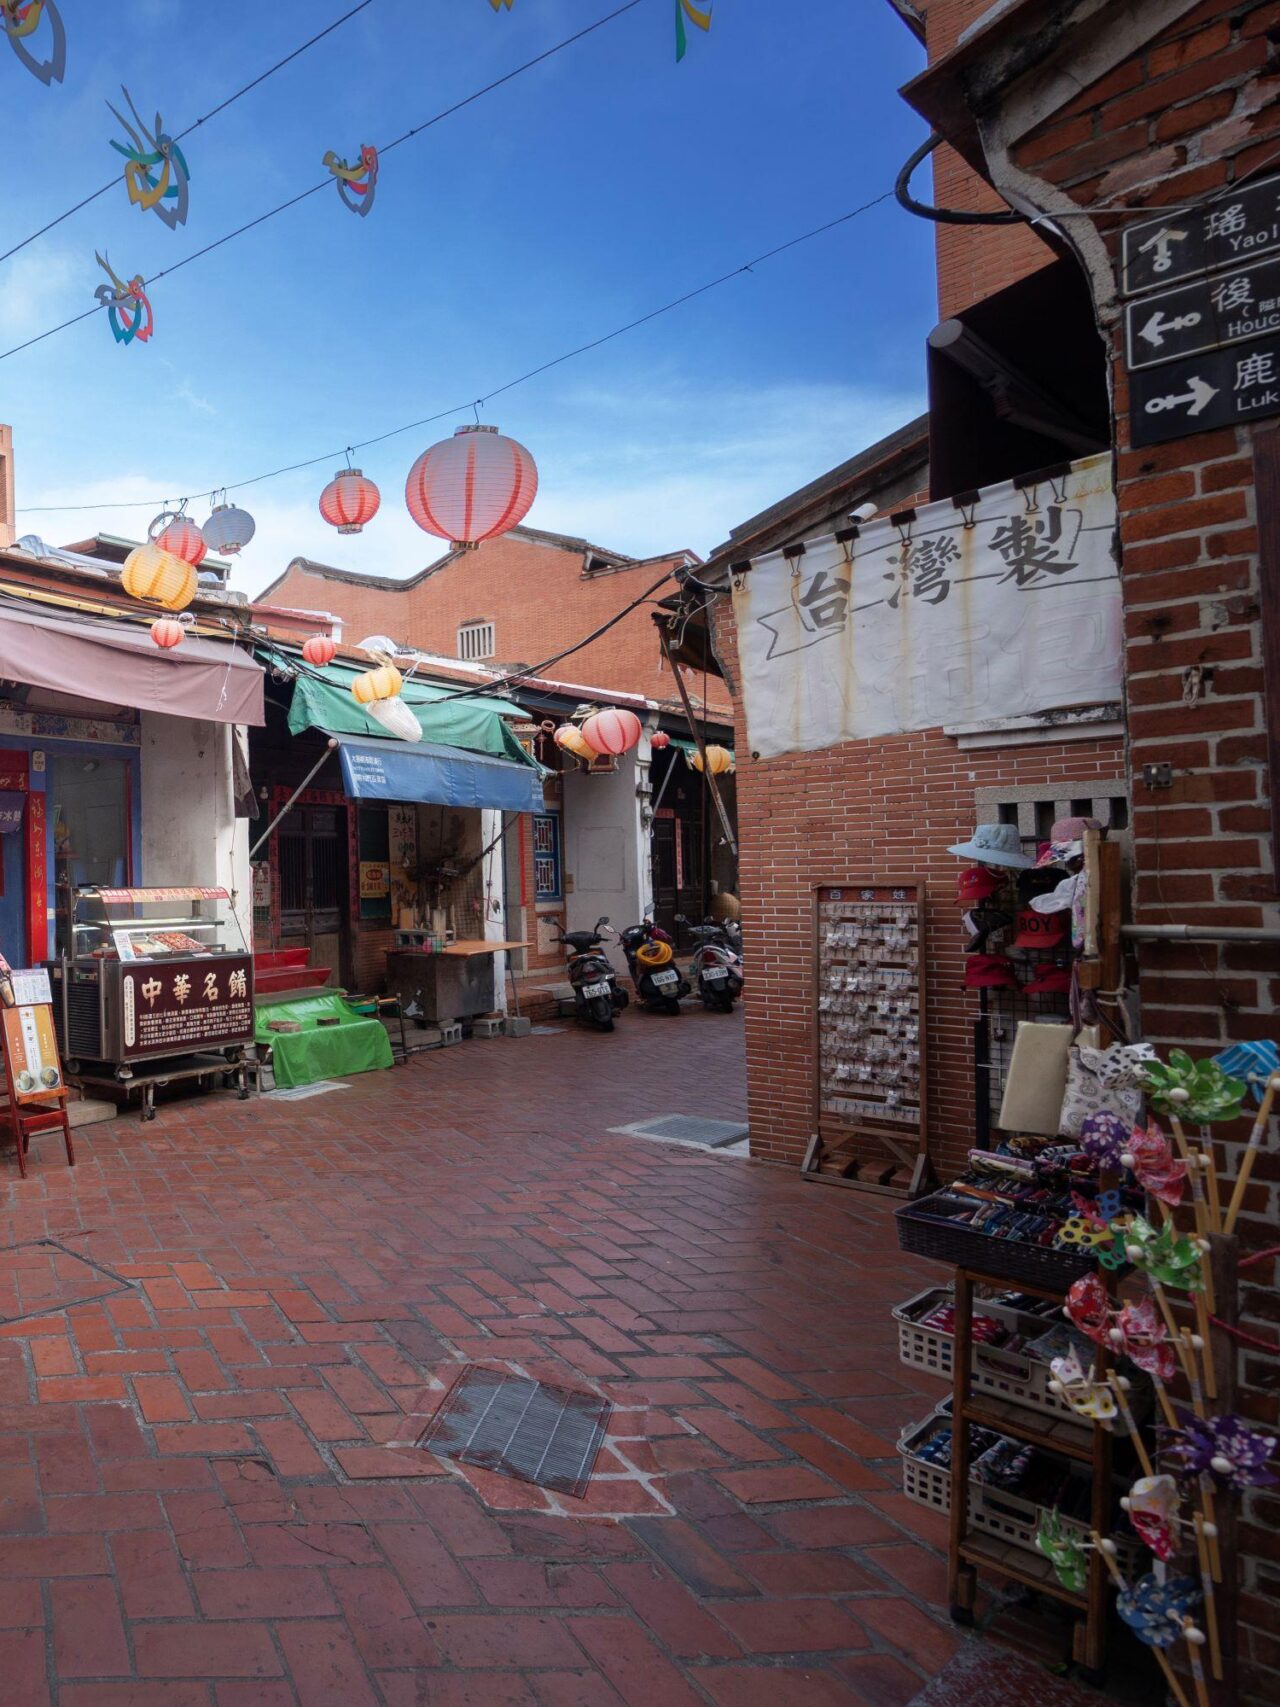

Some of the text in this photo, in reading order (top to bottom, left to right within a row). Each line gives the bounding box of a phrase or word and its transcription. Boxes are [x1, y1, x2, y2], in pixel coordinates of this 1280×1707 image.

[1211, 277, 1255, 313] 後
[1233, 352, 1277, 391] 鹿
[798, 505, 1079, 632] 台灣製
[1020, 917, 1051, 932] BOY
[141, 968, 247, 1009] 中華名餚
